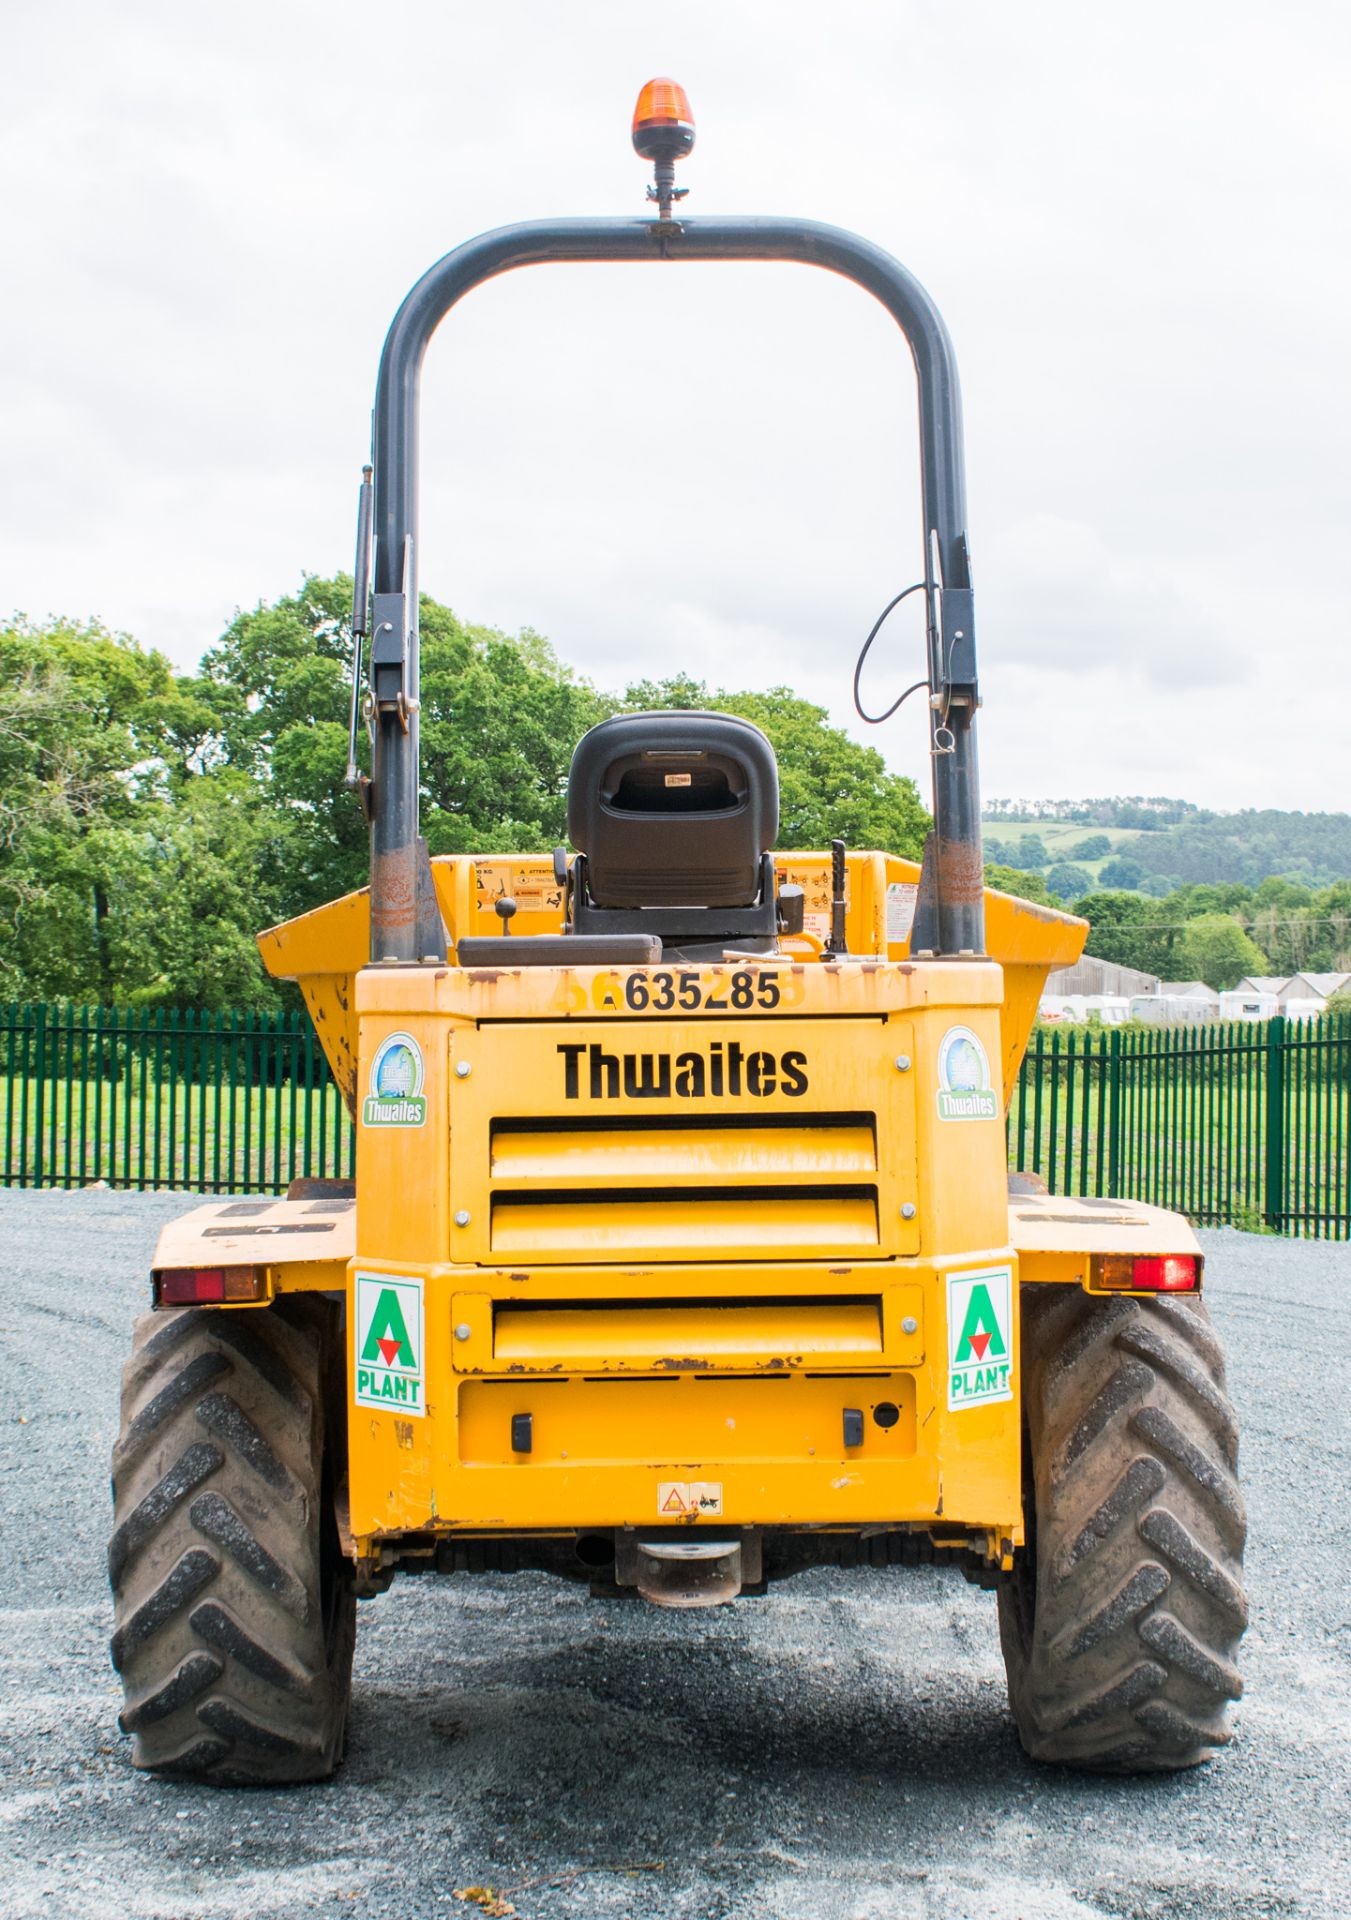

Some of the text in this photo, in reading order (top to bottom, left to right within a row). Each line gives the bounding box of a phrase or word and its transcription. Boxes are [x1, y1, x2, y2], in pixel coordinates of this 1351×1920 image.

[557, 1042, 808, 1099] Thwaites
[368, 1100, 422, 1121] Thwaites
[942, 1093, 993, 1115] Thwaites
[361, 1288, 417, 1368] A
[954, 1283, 1007, 1362] A
[358, 1370, 420, 1402] PLANT
[951, 1364, 1009, 1398] PLANT
